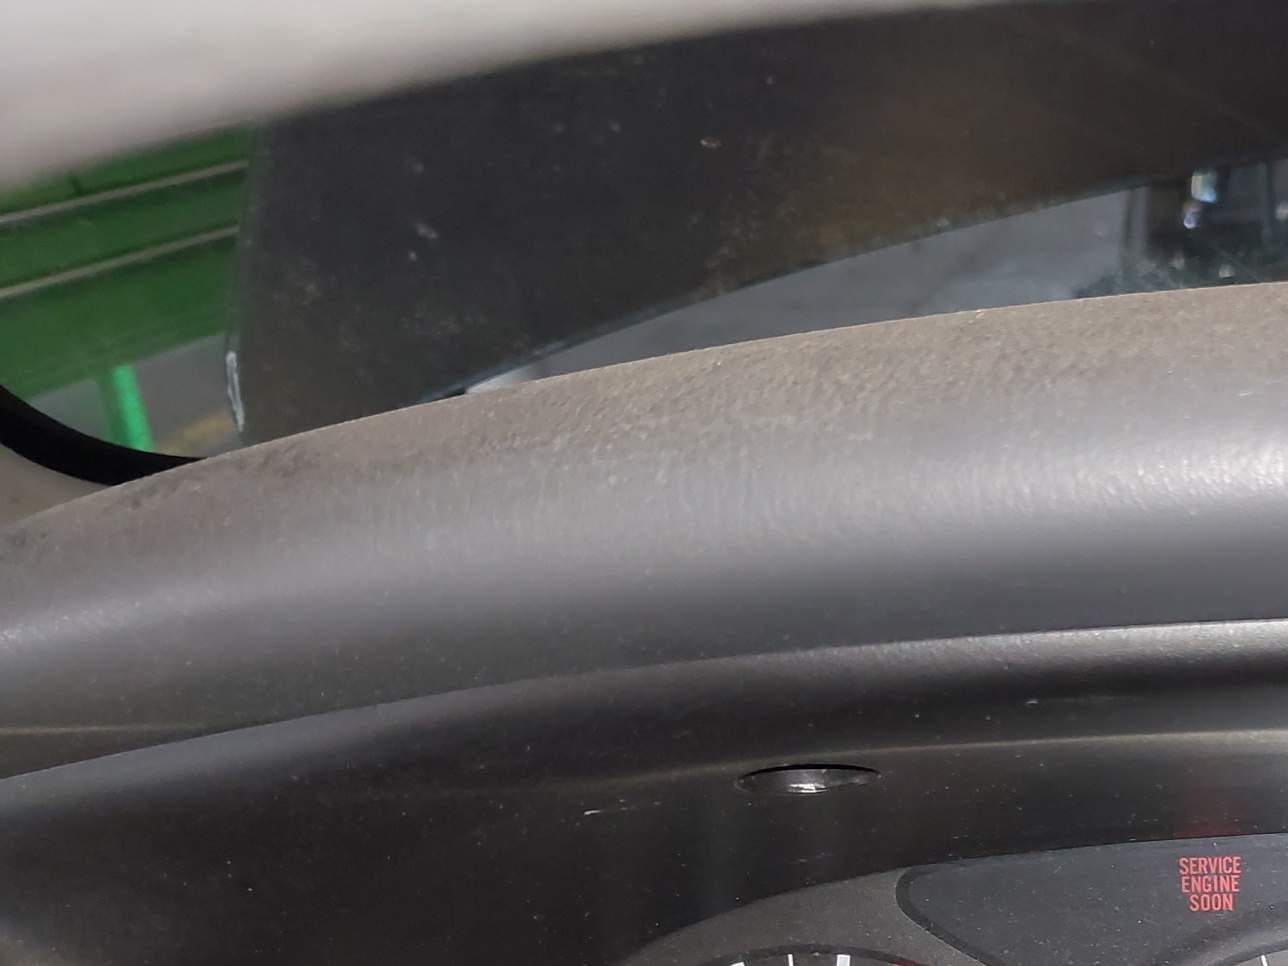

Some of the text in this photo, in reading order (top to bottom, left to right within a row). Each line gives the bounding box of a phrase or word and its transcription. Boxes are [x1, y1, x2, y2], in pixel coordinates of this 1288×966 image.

[1179, 856, 1242, 875] SERVICE
[1181, 875, 1240, 893] ENGINE
[1189, 893, 1234, 912] SOON
